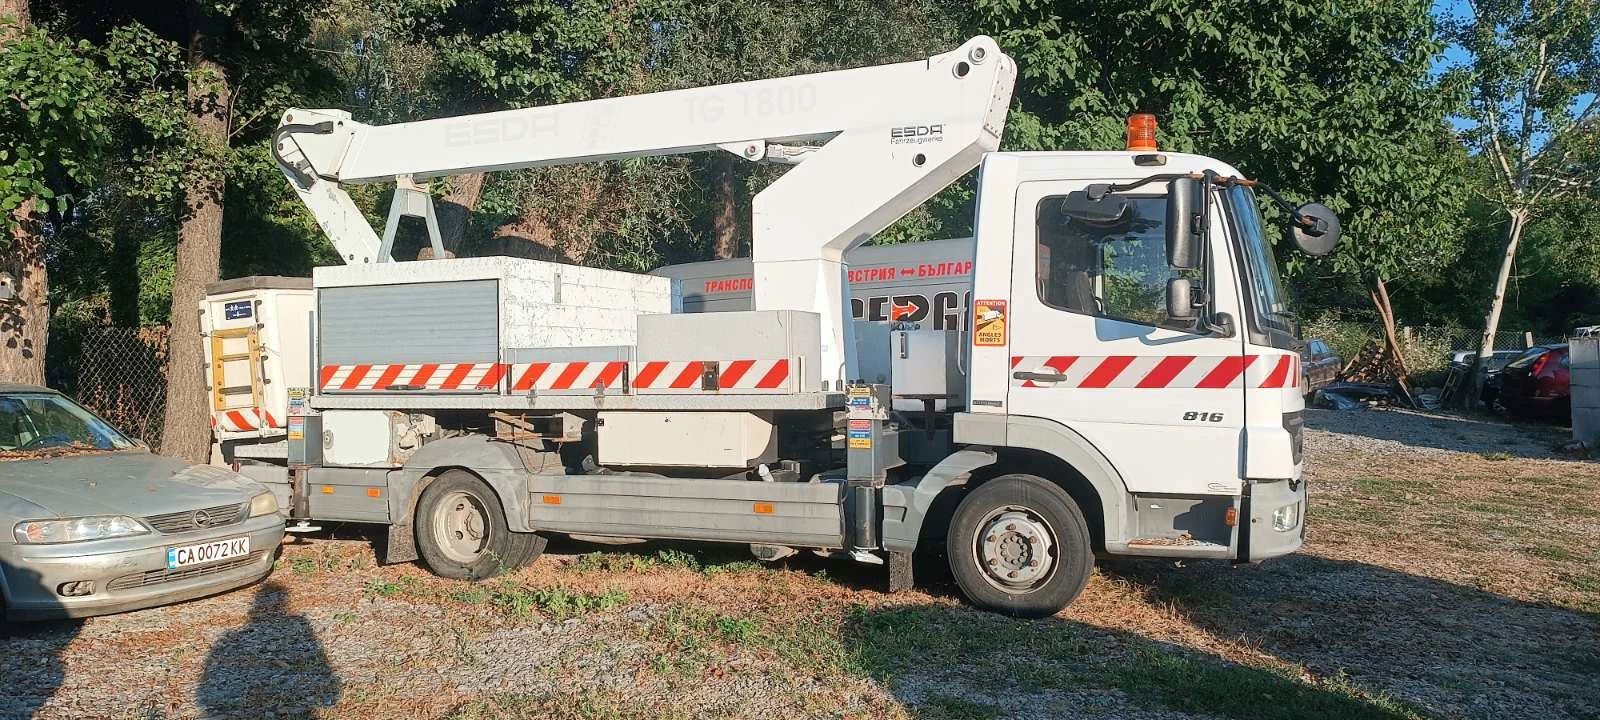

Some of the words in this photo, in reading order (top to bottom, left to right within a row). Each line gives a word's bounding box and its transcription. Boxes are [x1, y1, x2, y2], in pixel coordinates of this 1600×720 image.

[1182, 411, 1224, 422] 816
[177, 549, 195, 565] CA
[198, 542, 228, 561] 0072
[231, 538, 246, 555] KK
